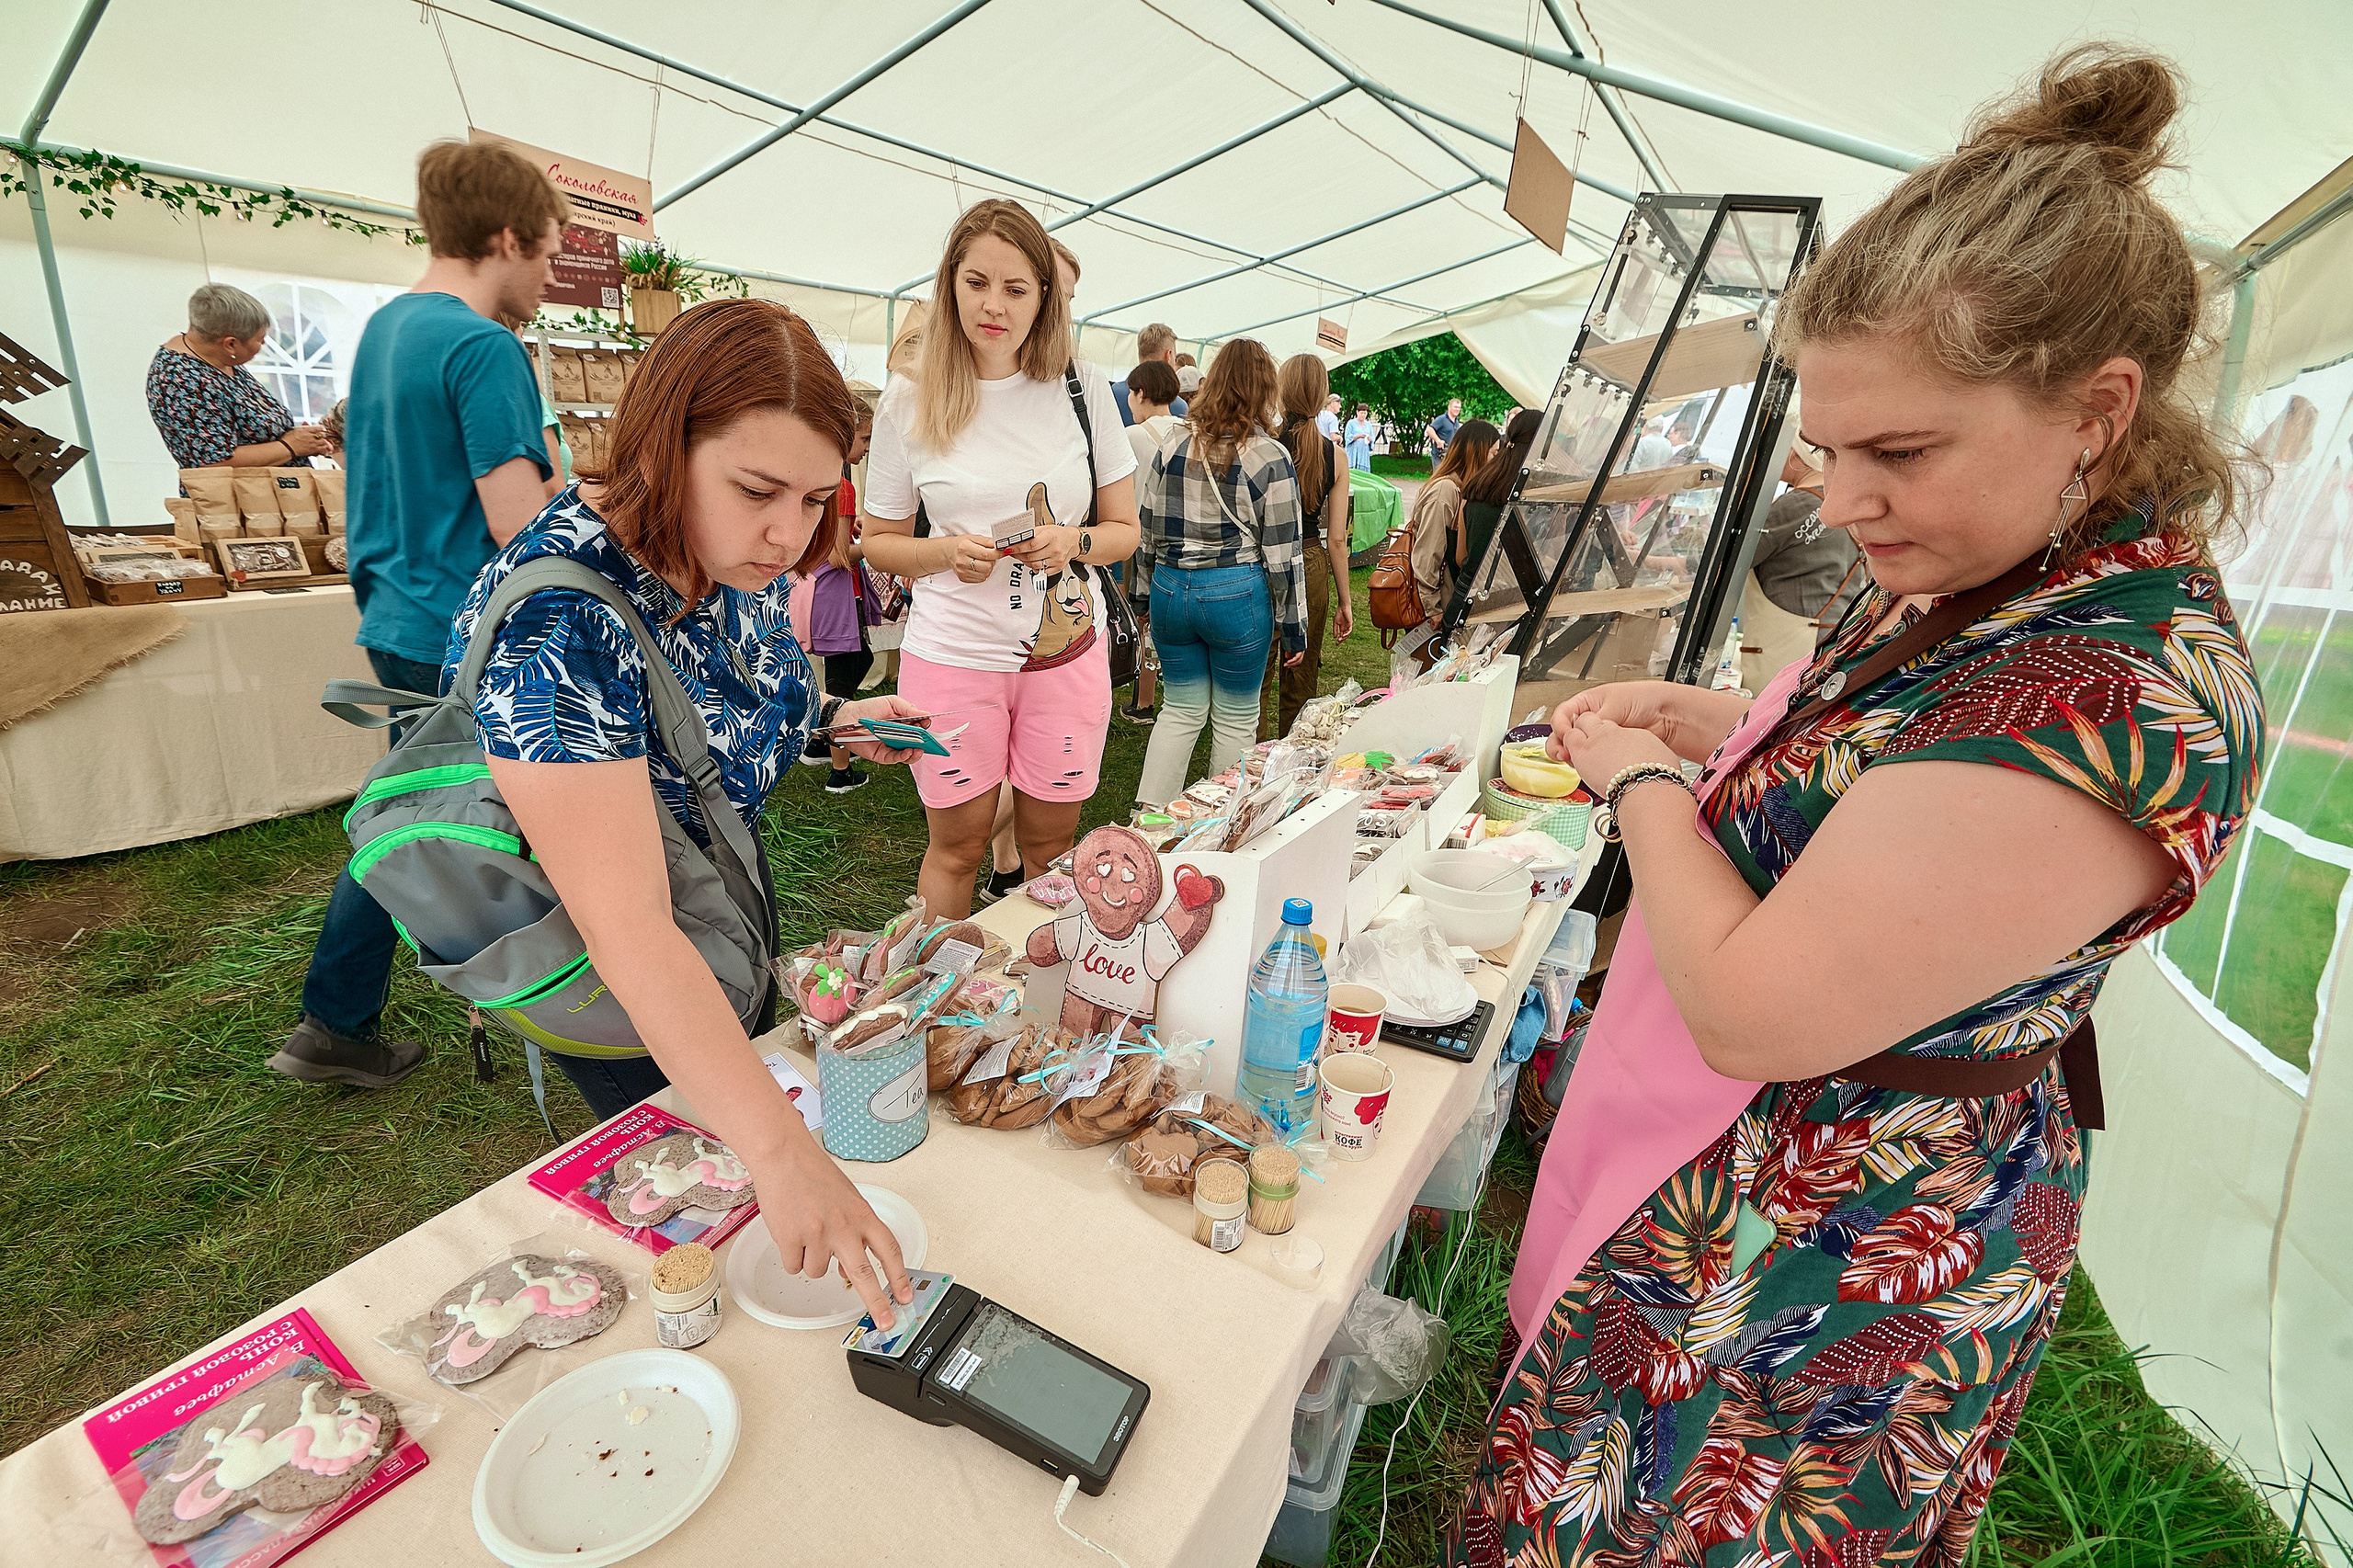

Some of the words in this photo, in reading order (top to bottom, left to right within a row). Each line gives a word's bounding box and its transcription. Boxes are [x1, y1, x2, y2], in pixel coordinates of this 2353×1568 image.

[547, 163, 639, 204] Соколовская
[1010, 562, 1024, 587] DRA
[1010, 595, 1023, 610] NO
[1079, 943, 1136, 984] love
[567, 984, 608, 1013] LUR
[591, 1113, 640, 1147] РОЗОВОЙ
[620, 1113, 655, 1136] КОНЬ
[1335, 1134, 1362, 1146] КОФЕ
[543, 1143, 591, 1176] ГРИВОЙ
[593, 1128, 651, 1168] Астафьев
[284, 1320, 293, 1330] С
[192, 1328, 285, 1378] РОЗОВОЙ
[239, 1326, 300, 1362] КОНЬ
[284, 1339, 306, 1355] В.
[108, 1375, 189, 1425] ГРИВОЙ
[174, 1356, 278, 1417] Астафьев
[234, 1531, 292, 1568] КЛАСС
